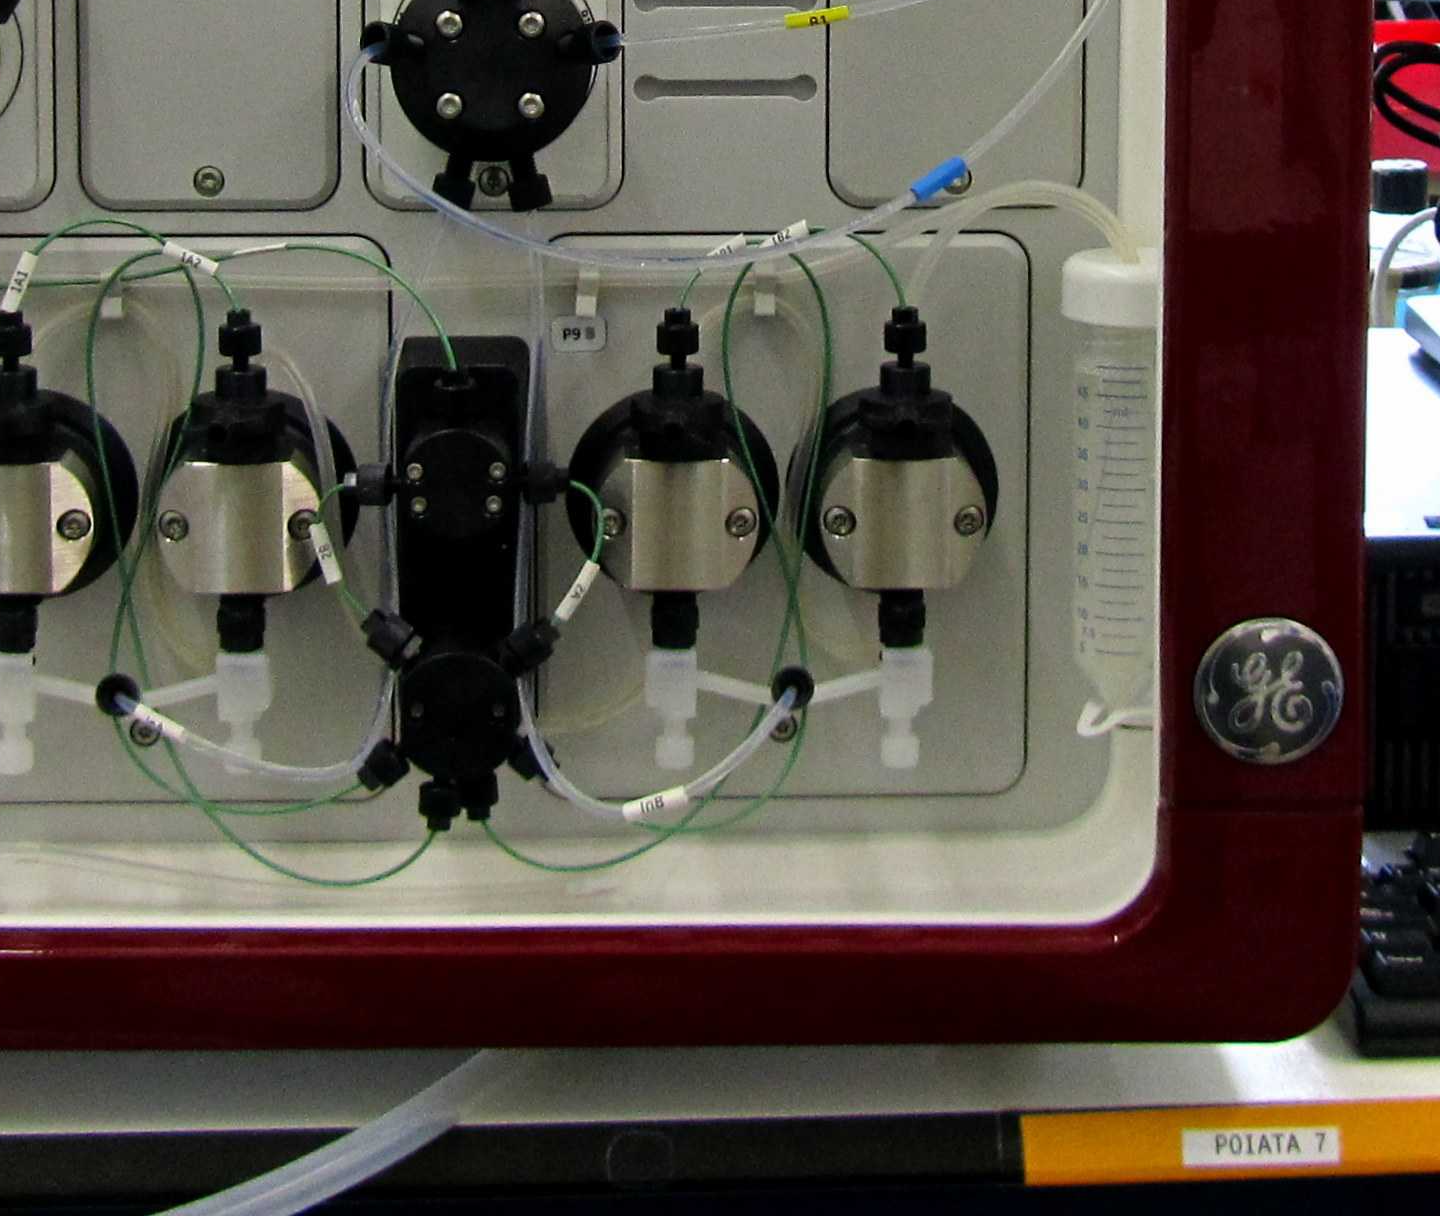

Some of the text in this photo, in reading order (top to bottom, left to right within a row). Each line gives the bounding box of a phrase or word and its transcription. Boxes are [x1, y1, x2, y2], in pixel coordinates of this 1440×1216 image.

[10, 270, 29, 293] 1A1
[563, 328, 581, 341] P9
[640, 794, 665, 814] InB
[1215, 1132, 1327, 1155] POIATA 7
